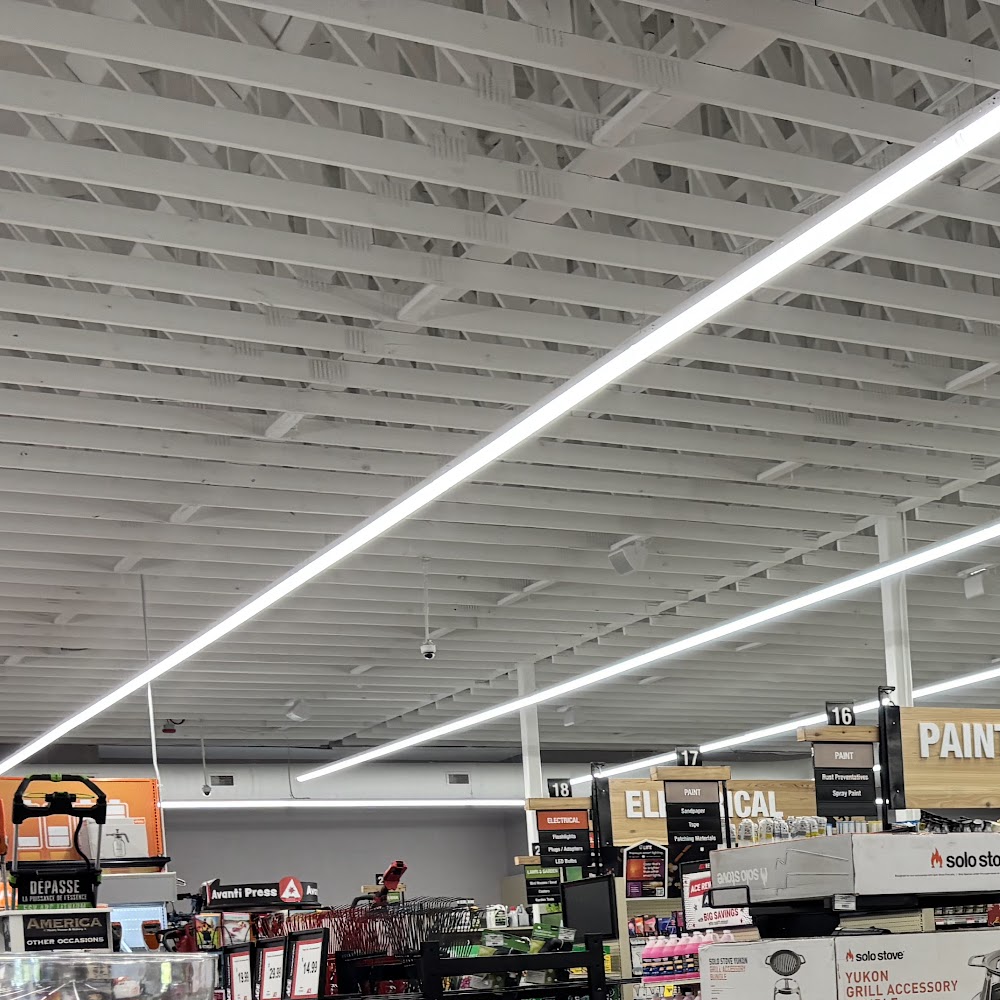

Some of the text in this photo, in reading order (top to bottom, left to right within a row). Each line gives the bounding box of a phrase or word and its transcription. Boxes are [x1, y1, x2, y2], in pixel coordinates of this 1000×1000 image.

[831, 706, 852, 725] 16
[680, 750, 699, 766] 17
[834, 751, 854, 760] PAINT
[552, 782, 570, 797] 18
[684, 788, 701, 796] PAINT
[832, 789, 862, 798] Spray Paint
[625, 789, 784, 819] ELICAL
[680, 807, 706, 815] Sandpaper
[547, 816, 580, 824] ELECTRICAL
[945, 852, 976, 869] solo
[211, 887, 278, 900] Avanti Press
[690, 883, 702, 893] ACE
[703, 908, 739, 922] BIG SAVINGS
[27, 917, 103, 930] AMERICA
[27, 936, 105, 946] OTHER OCCASIONS
[855, 950, 904, 962] solo stove
[845, 970, 889, 984] YUKON
[846, 980, 959, 998] GRILL ACCESSORY
